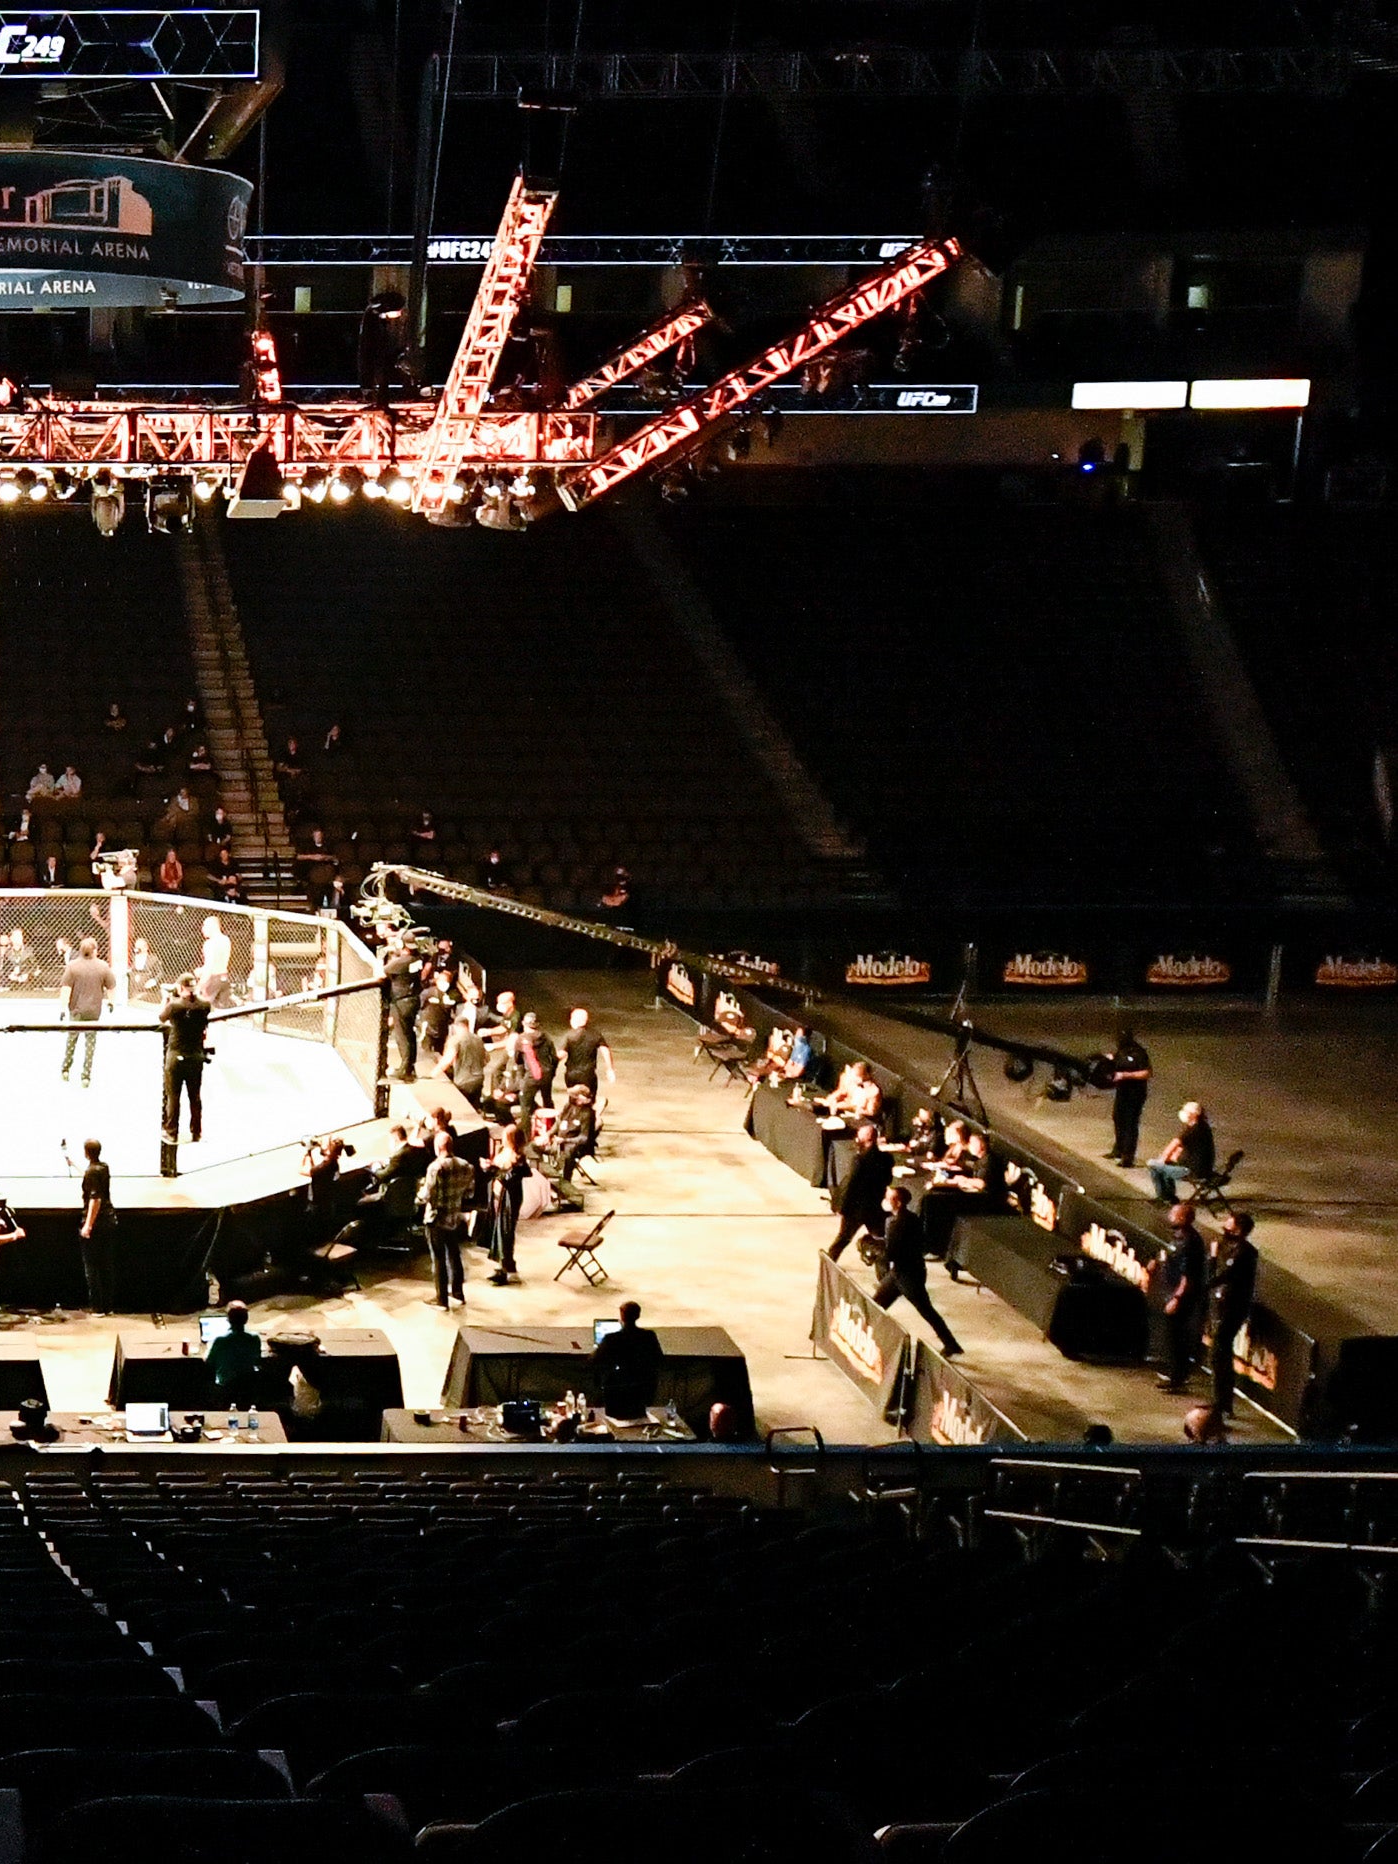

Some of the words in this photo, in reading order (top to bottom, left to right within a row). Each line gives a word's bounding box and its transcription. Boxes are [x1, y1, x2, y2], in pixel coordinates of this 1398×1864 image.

[20, 35, 65, 58] 249
[91, 241, 150, 261] ARENA
[427, 241, 495, 260] #UFC24
[40, 279, 97, 294] ARENA
[857, 954, 920, 977] Modelo
[1015, 954, 1079, 977] Modelo
